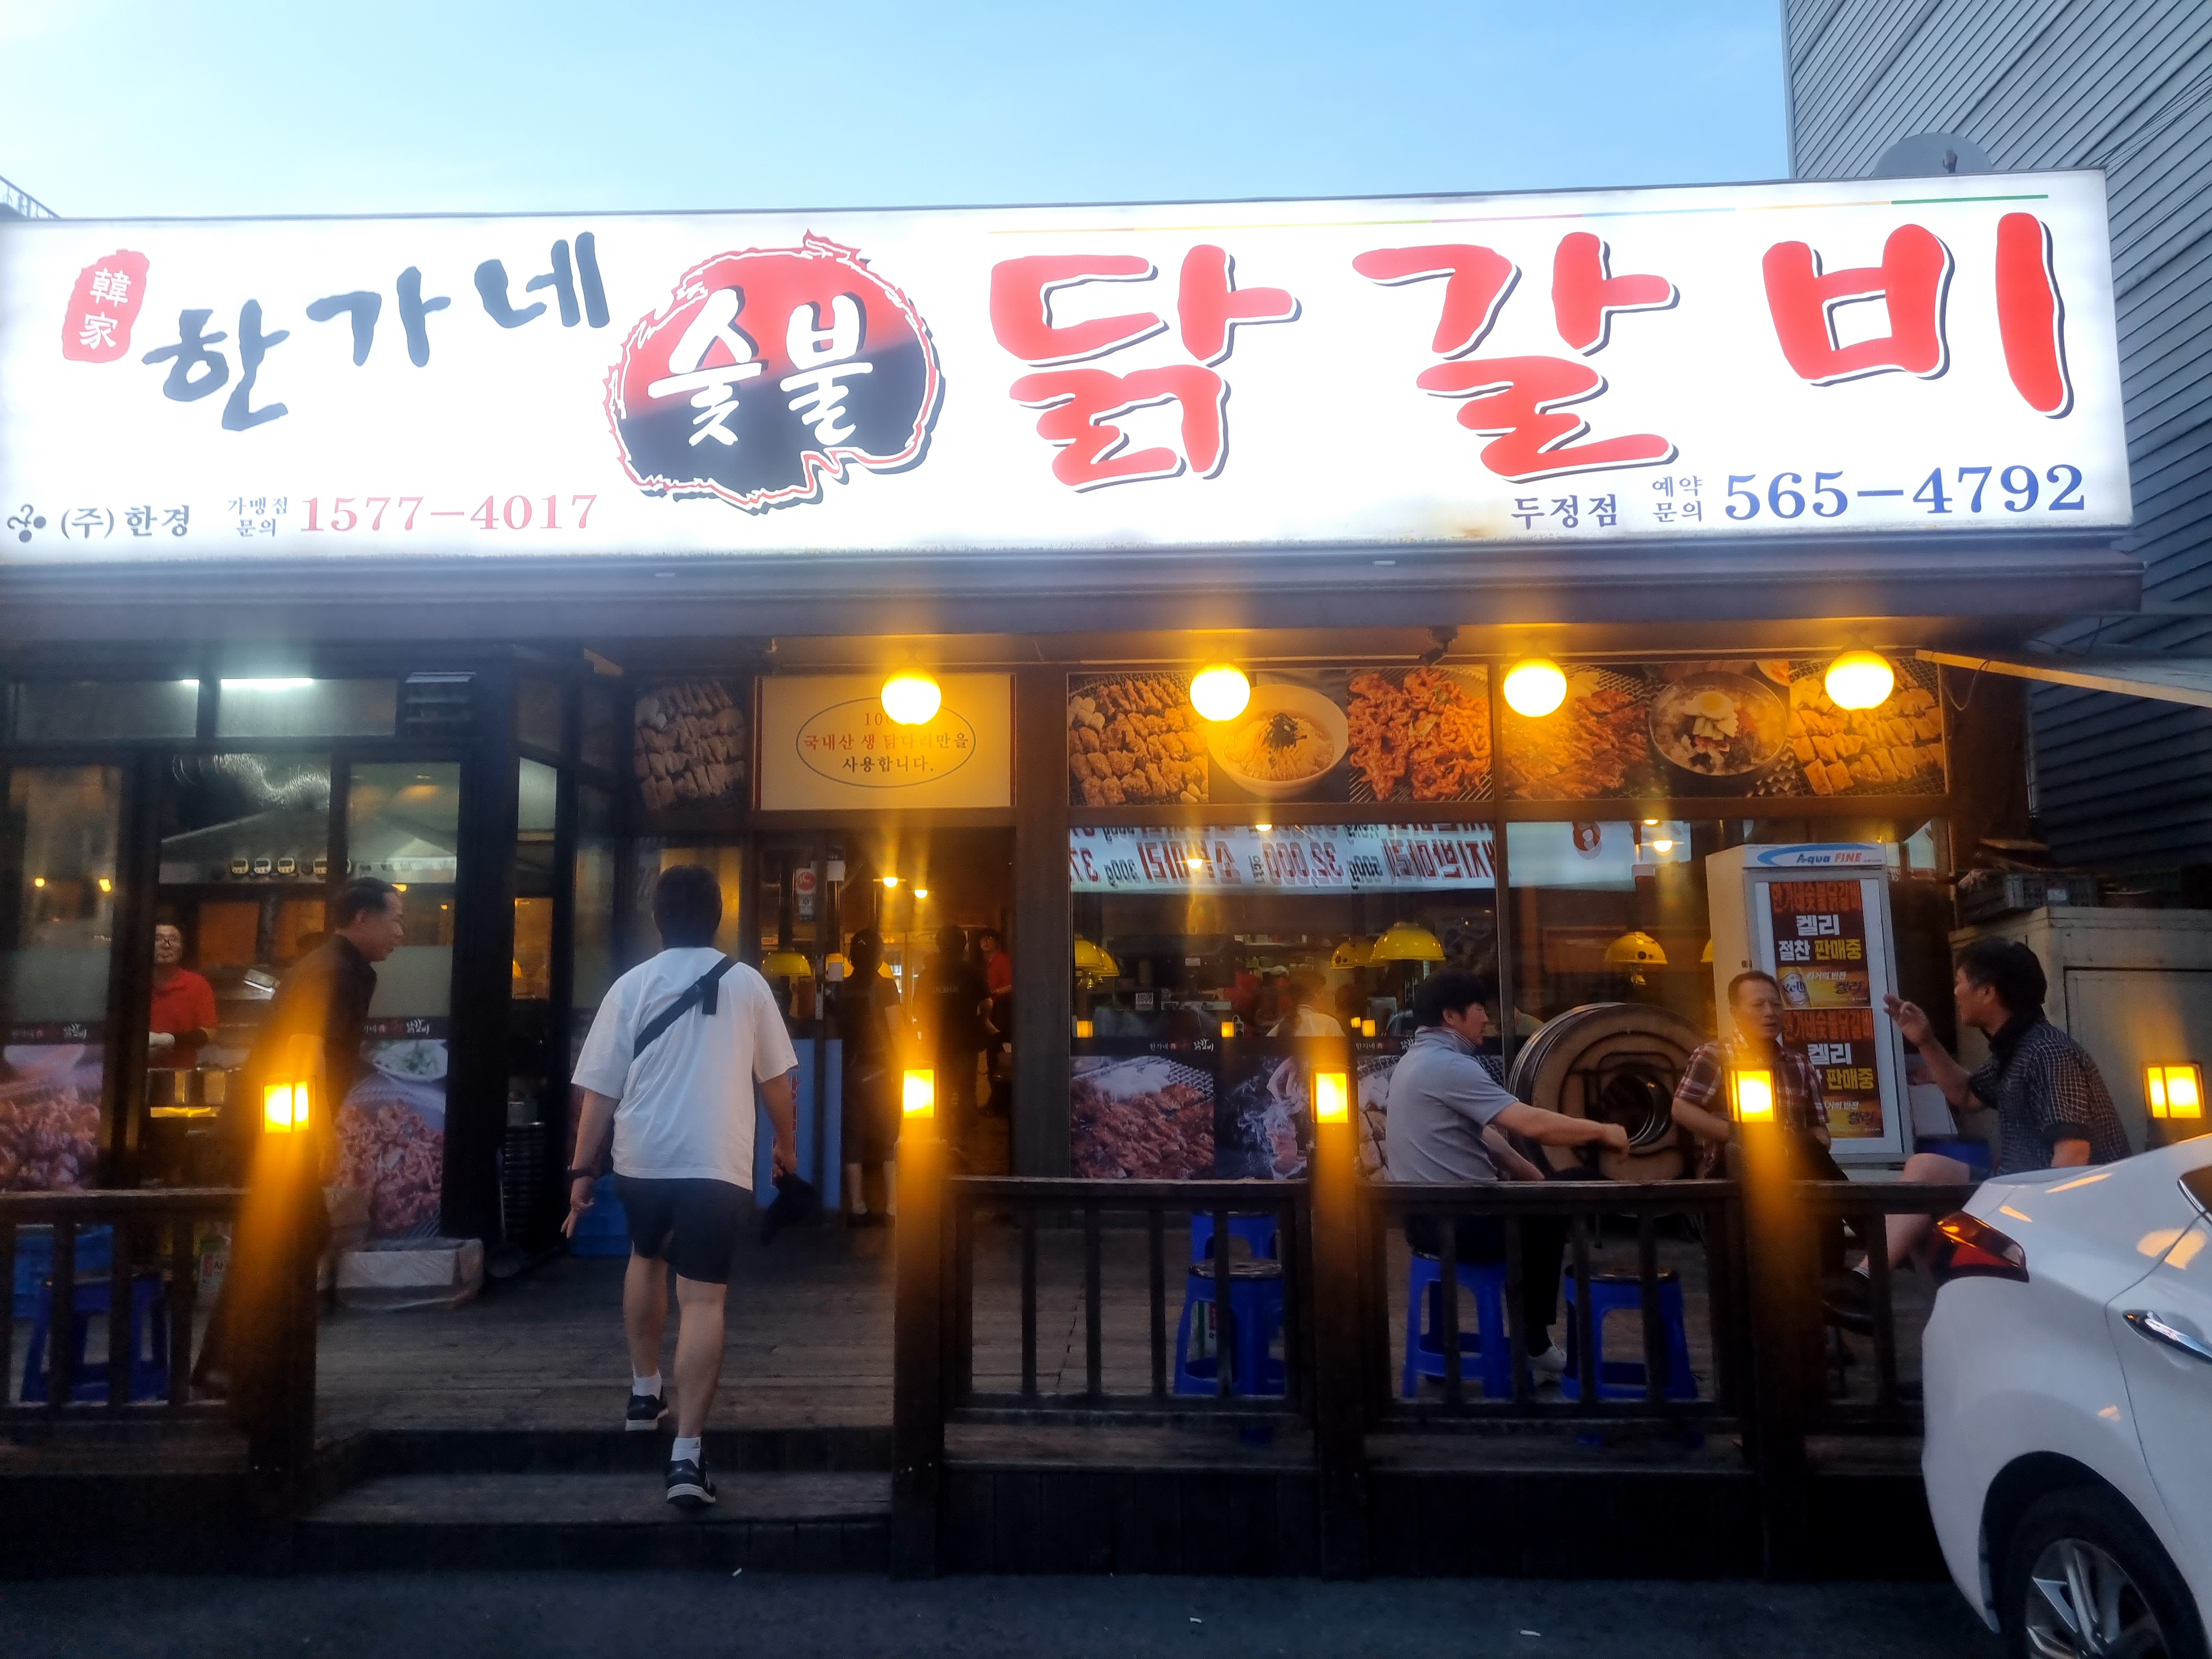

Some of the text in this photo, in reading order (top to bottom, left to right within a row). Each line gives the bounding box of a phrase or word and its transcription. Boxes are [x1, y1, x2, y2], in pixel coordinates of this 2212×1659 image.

[79, 269, 132, 350] 韓家
[142, 212, 2074, 494] 한가네 숯불 닭갈비
[1651, 476, 1703, 498] 예약
[1725, 464, 2086, 521] 565-4792
[227, 496, 288, 516] 가맹점
[301, 494, 598, 533] 1577-4017
[1511, 494, 1618, 529] 두정점
[1652, 500, 1703, 524] 문의
[236, 518, 276, 538] 문의
[803, 732, 969, 751] 국내산 생 닭다리만을
[842, 755, 934, 774] 사용합니다.
[1796, 853, 1831, 865] Aqua
[1835, 852, 1863, 863] FINE
[1796, 914, 1840, 936] 켈리
[1779, 939, 1862, 961] 절찬 판매중
[1808, 1043, 1852, 1065] 켈리
[1826, 1068, 1874, 1090] 판매중
